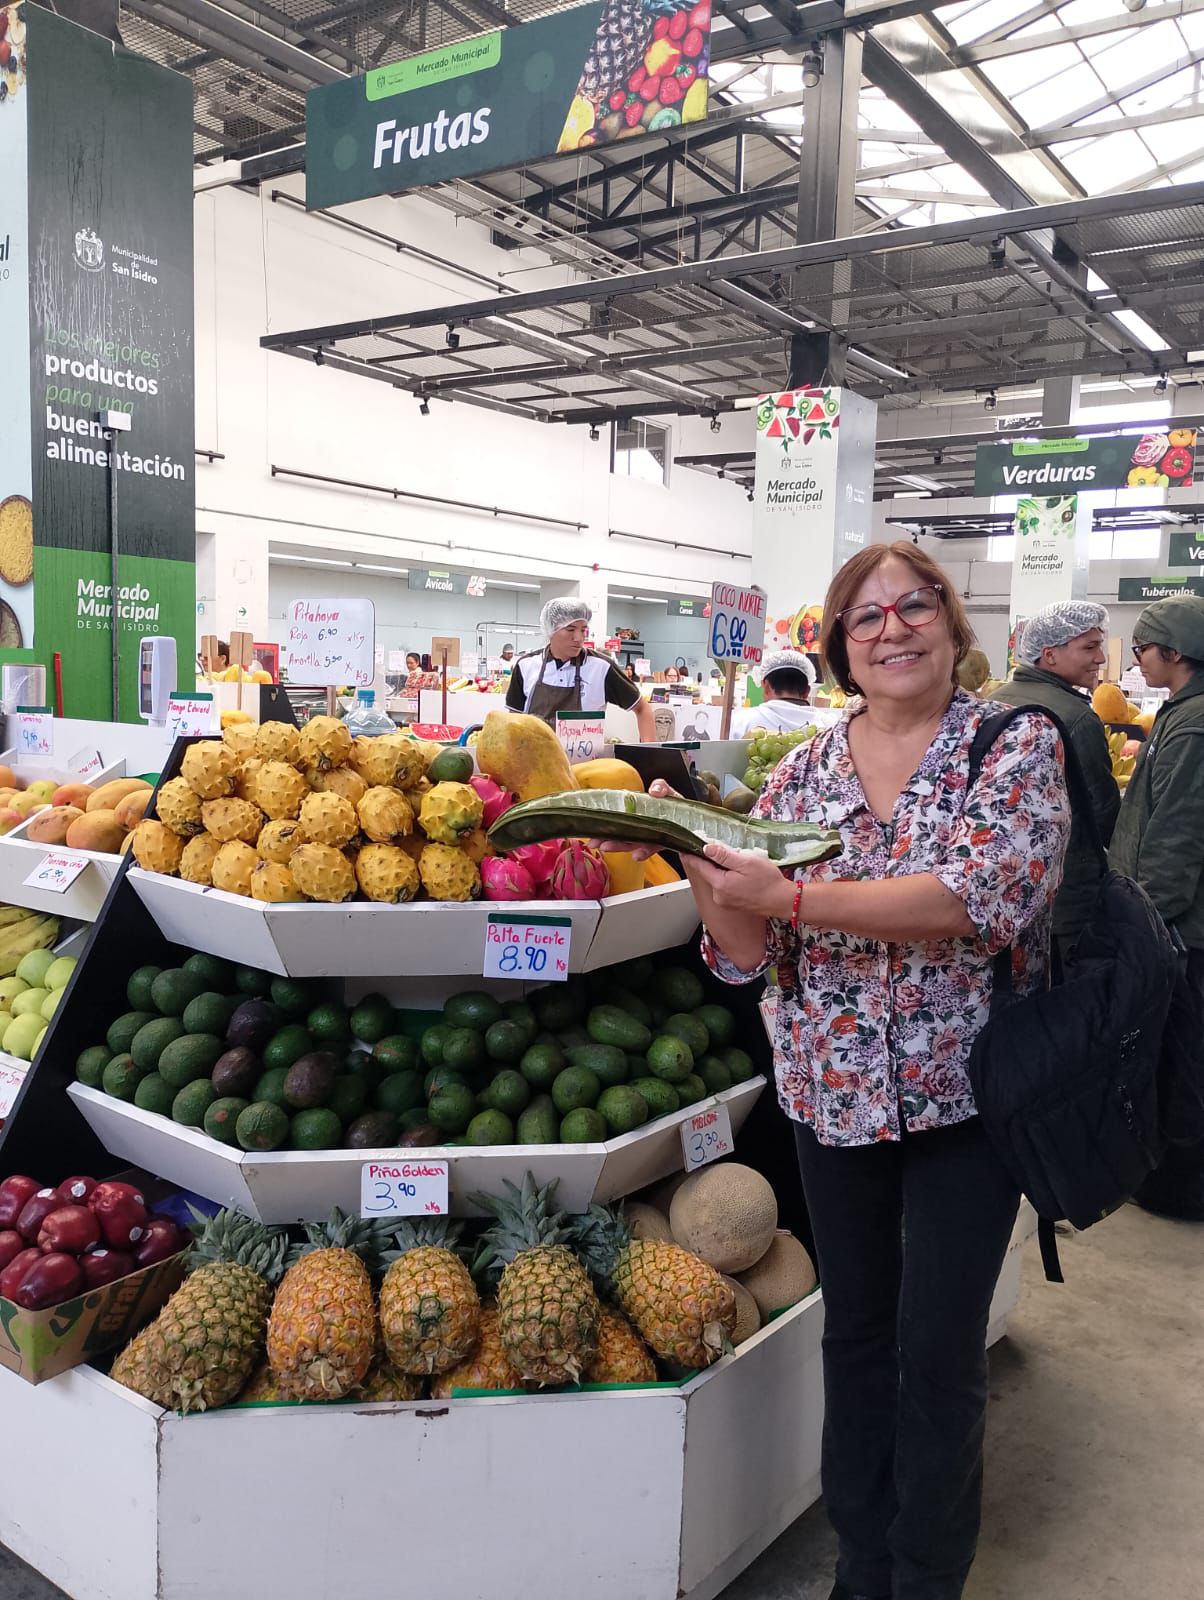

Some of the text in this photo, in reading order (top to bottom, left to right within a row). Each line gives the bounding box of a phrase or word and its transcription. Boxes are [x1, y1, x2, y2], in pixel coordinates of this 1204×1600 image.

[416, 44, 490, 75] Mercado Municipal
[373, 107, 492, 169] Frutas
[111, 244, 158, 266] Municipalidad
[130, 261, 140, 269] de
[112, 262, 158, 285] San Isidro
[44, 323, 160, 368] Los mejores
[45, 354, 159, 396] productos
[45, 383, 135, 417] para una
[767, 476, 817, 492] Mercado
[1002, 462, 1097, 486] Verduras
[766, 489, 824, 505] Municipal
[1021, 560, 1064, 571] Municipal
[1022, 553, 1059, 562] Mercado
[293, 601, 340, 624] Pitahaya
[714, 584, 765, 620] COCO NORTE
[77, 620, 159, 633] DE SA ISIDRO
[289, 626, 309, 646] Roja
[168, 700, 186, 715] Mango
[487, 924, 566, 945] Palta Fuerte
[499, 945, 547, 972] 8.90
[369, 1164, 446, 1179] Piña Golden
[365, 1181, 417, 1212] 3.90
